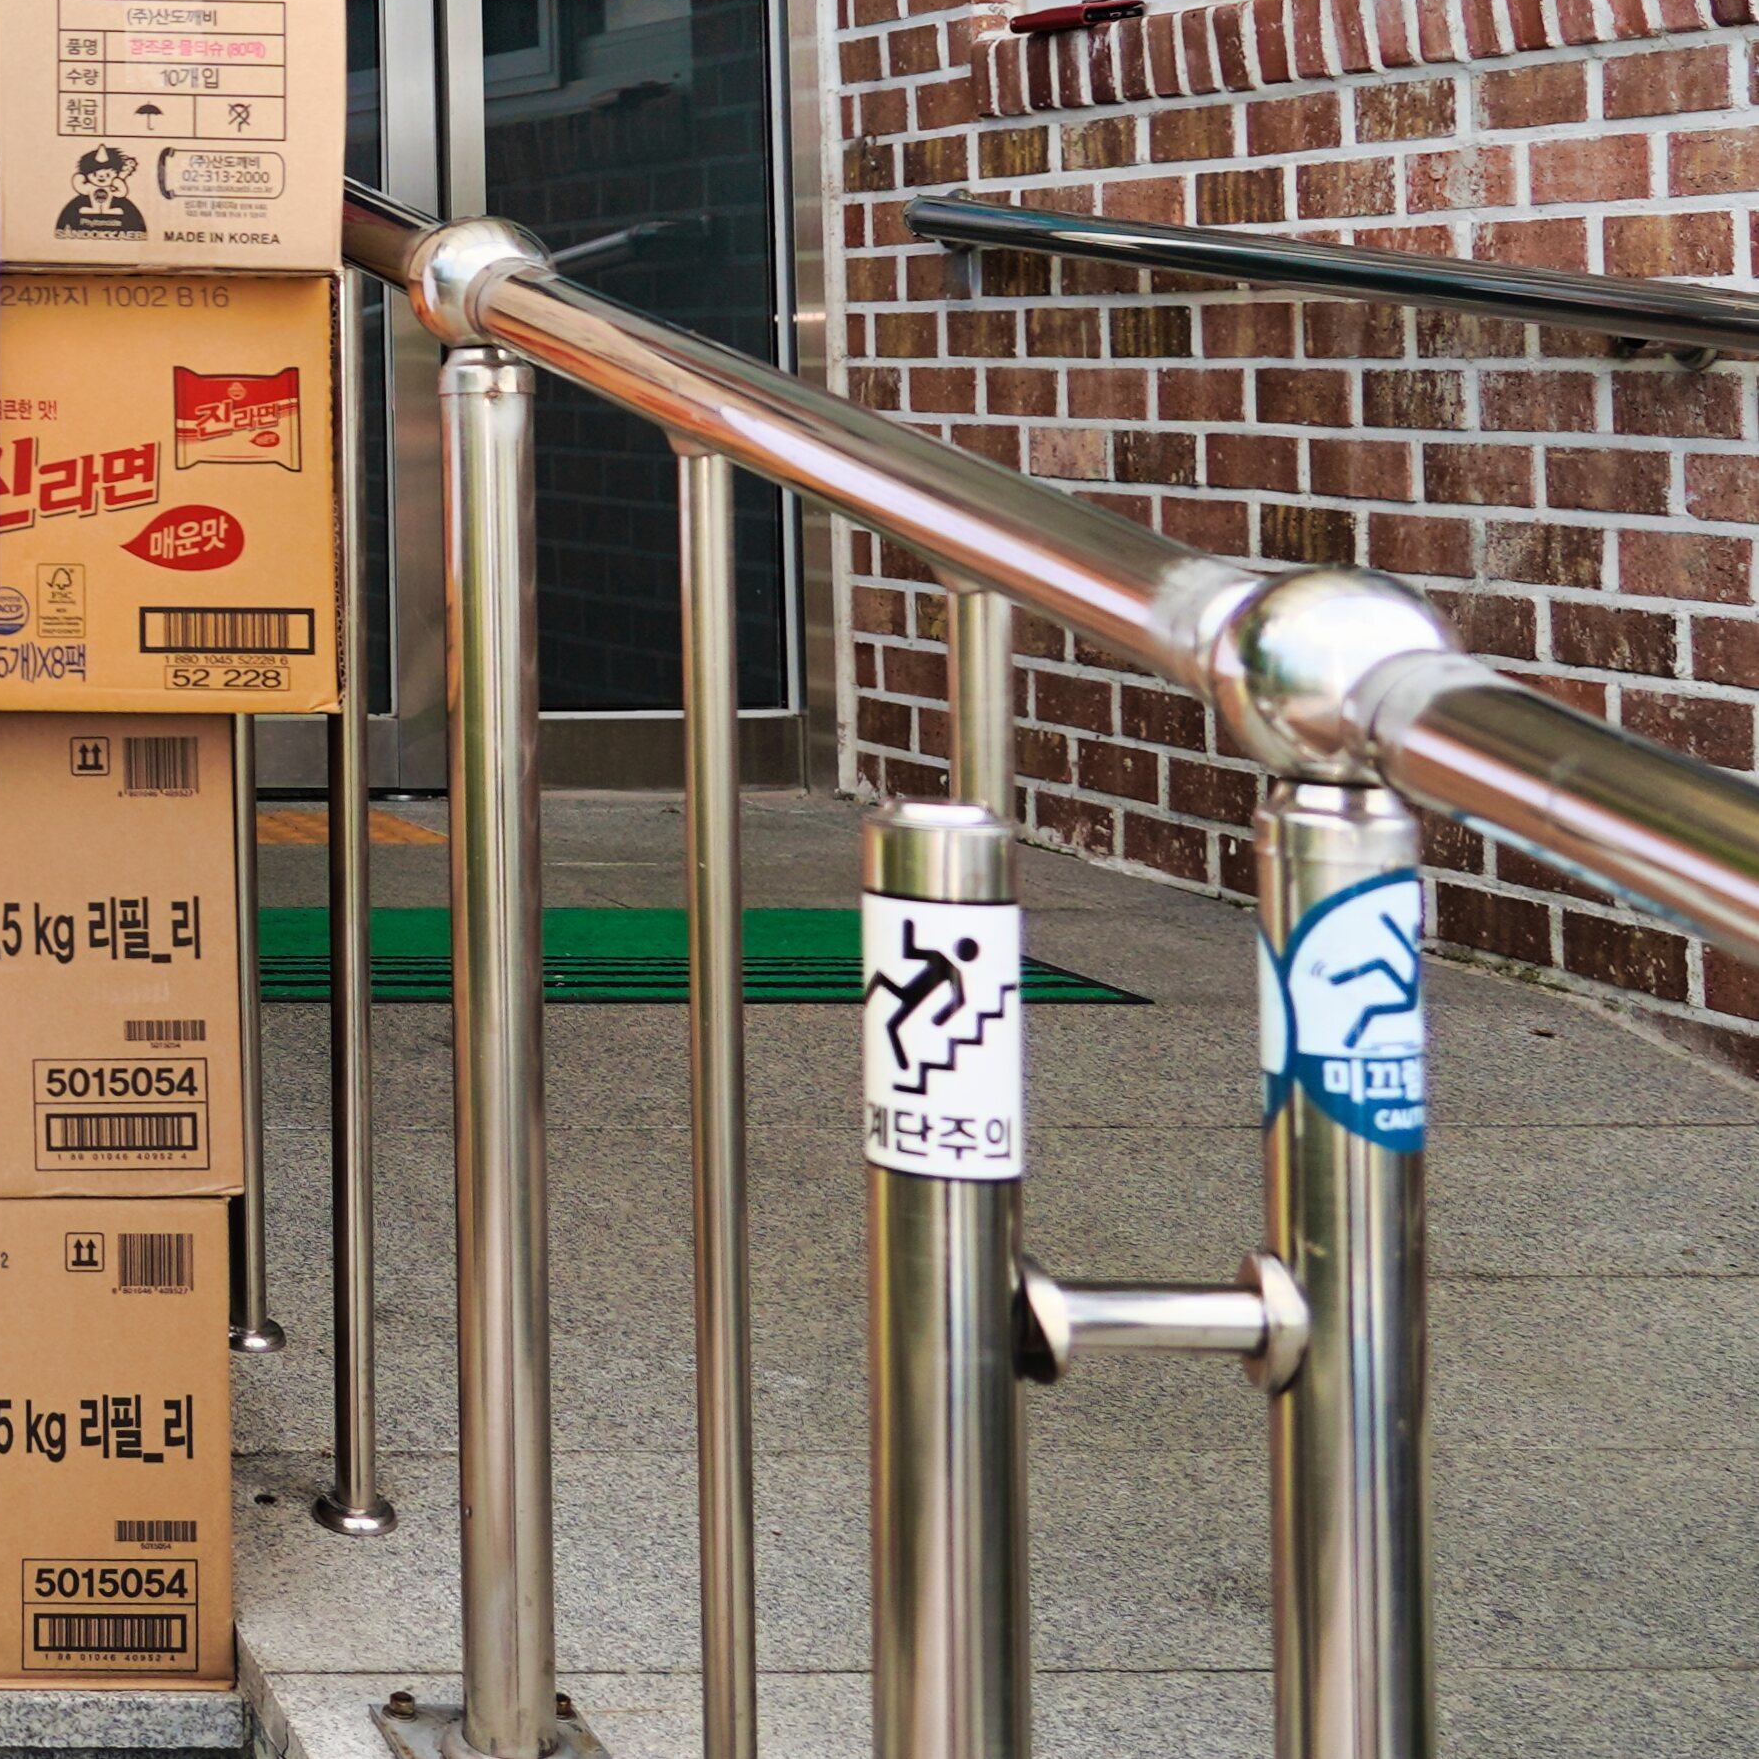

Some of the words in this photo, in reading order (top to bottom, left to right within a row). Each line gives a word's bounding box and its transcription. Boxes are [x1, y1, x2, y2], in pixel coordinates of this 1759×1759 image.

[126, 8, 218, 28] (주)산도깨비
[103, 286, 167, 307] 1002
[39, 401, 57, 420] 맛!
[195, 402, 281, 437] 진라면
[148, 516, 229, 559] 매운맛
[173, 669, 208, 688] 52
[219, 669, 281, 689] 228
[35, 903, 74, 964] kg
[88, 896, 200, 963] 리필_리
[46, 1068, 198, 1097] 5015054
[868, 1101, 1012, 1160] 계단주의
[35, 1568, 188, 1598] 5015054
